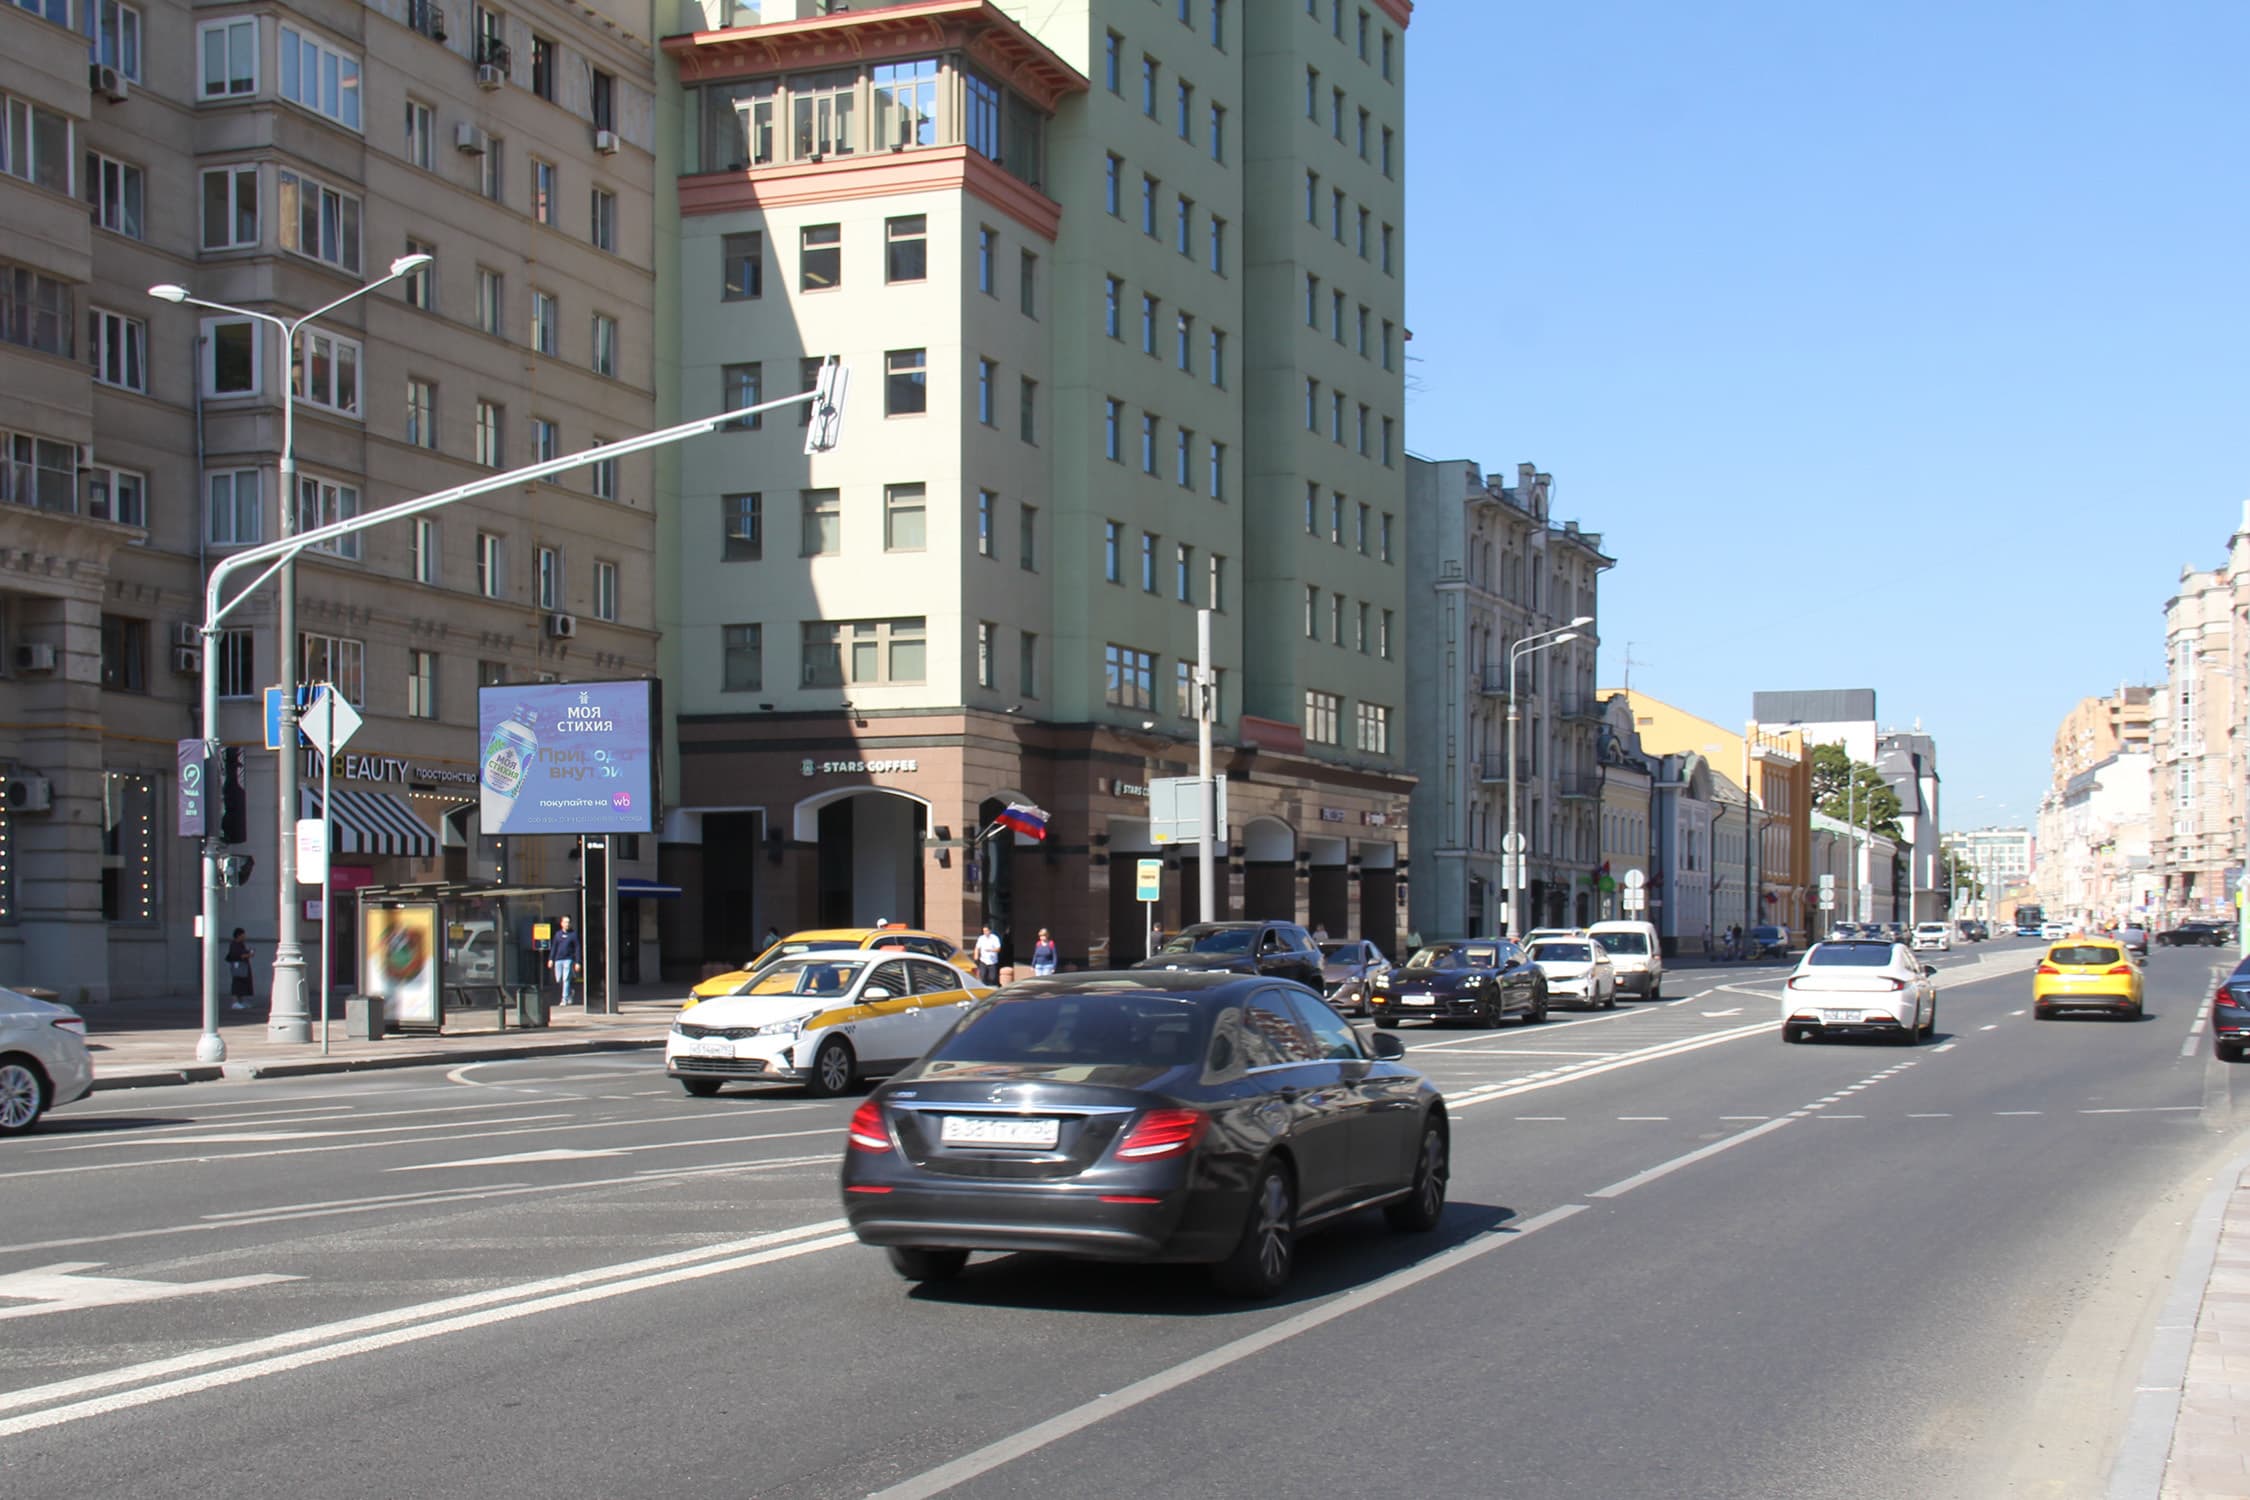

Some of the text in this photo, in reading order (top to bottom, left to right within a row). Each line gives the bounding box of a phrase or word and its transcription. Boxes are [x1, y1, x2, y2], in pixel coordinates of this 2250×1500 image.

[567, 706, 601, 719] МОЯ
[557, 721, 613, 732] СТИХИЯ
[496, 754, 517, 769] МОЯ
[538, 748, 633, 764] Природ
[488, 760, 519, 779] СТИХИЯ
[823, 759, 917, 773] STARS COFFEE
[416, 768, 477, 784] пространство
[539, 796, 631, 809] покупайте на wb
